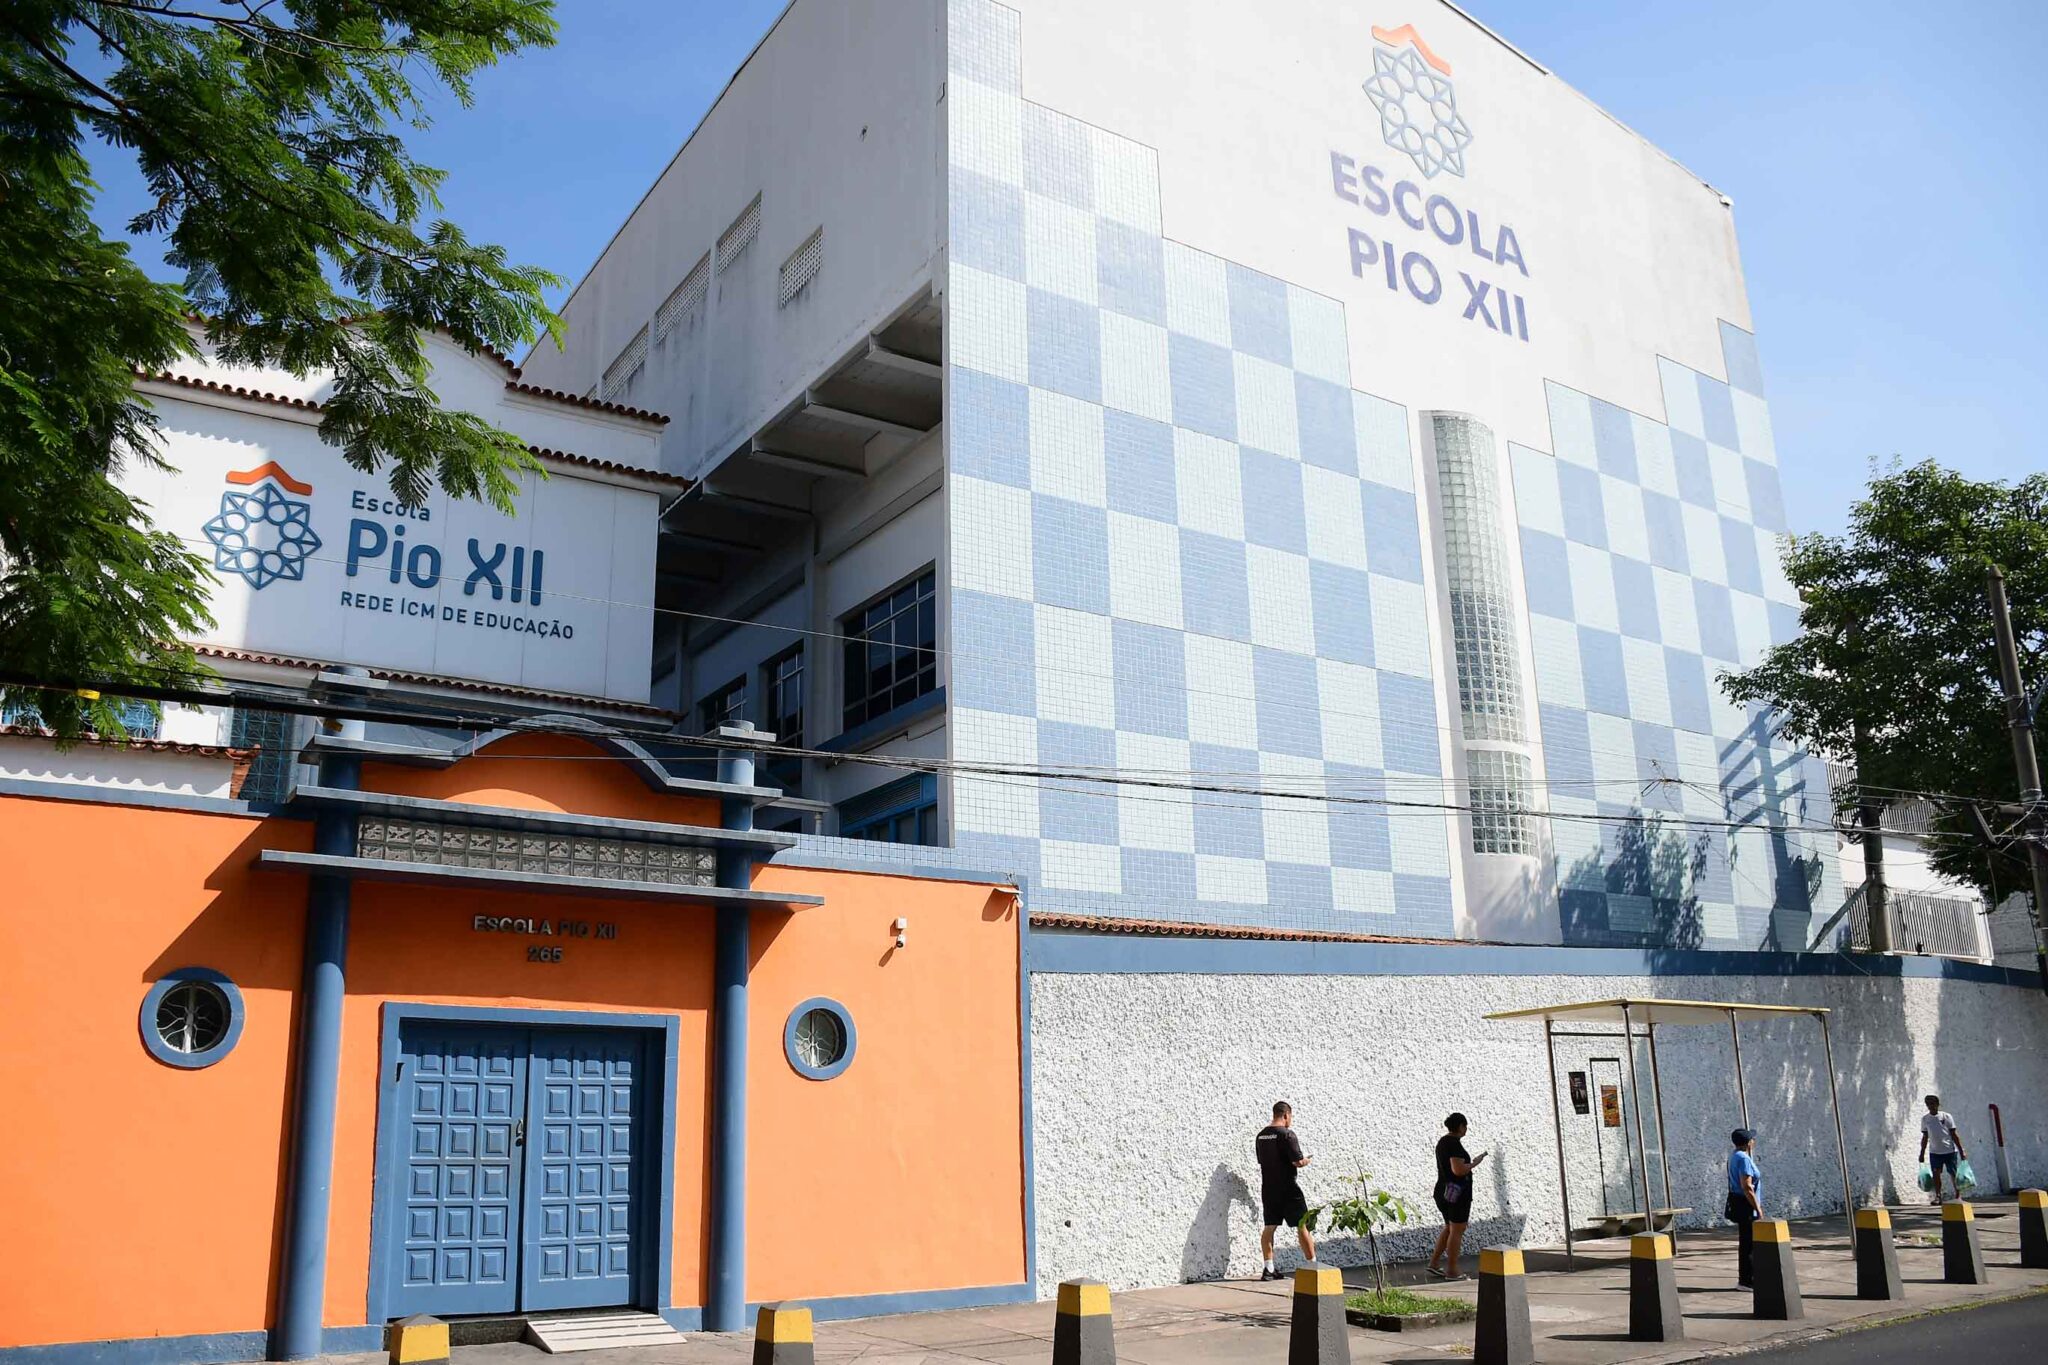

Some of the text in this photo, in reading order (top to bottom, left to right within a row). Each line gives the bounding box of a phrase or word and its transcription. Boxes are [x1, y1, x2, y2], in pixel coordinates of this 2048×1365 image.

[1330, 151, 1530, 278] ESCOLA
[1348, 226, 1530, 343] PIO XII
[351, 490, 431, 522] Escola
[346, 518, 544, 606] Pio XII
[340, 591, 394, 613] REDE
[442, 607, 467, 624] DE
[473, 611, 574, 640] EDUCAÇÃO
[473, 914, 619, 940] ESCOLA PIO XII
[527, 944, 564, 963] 265
